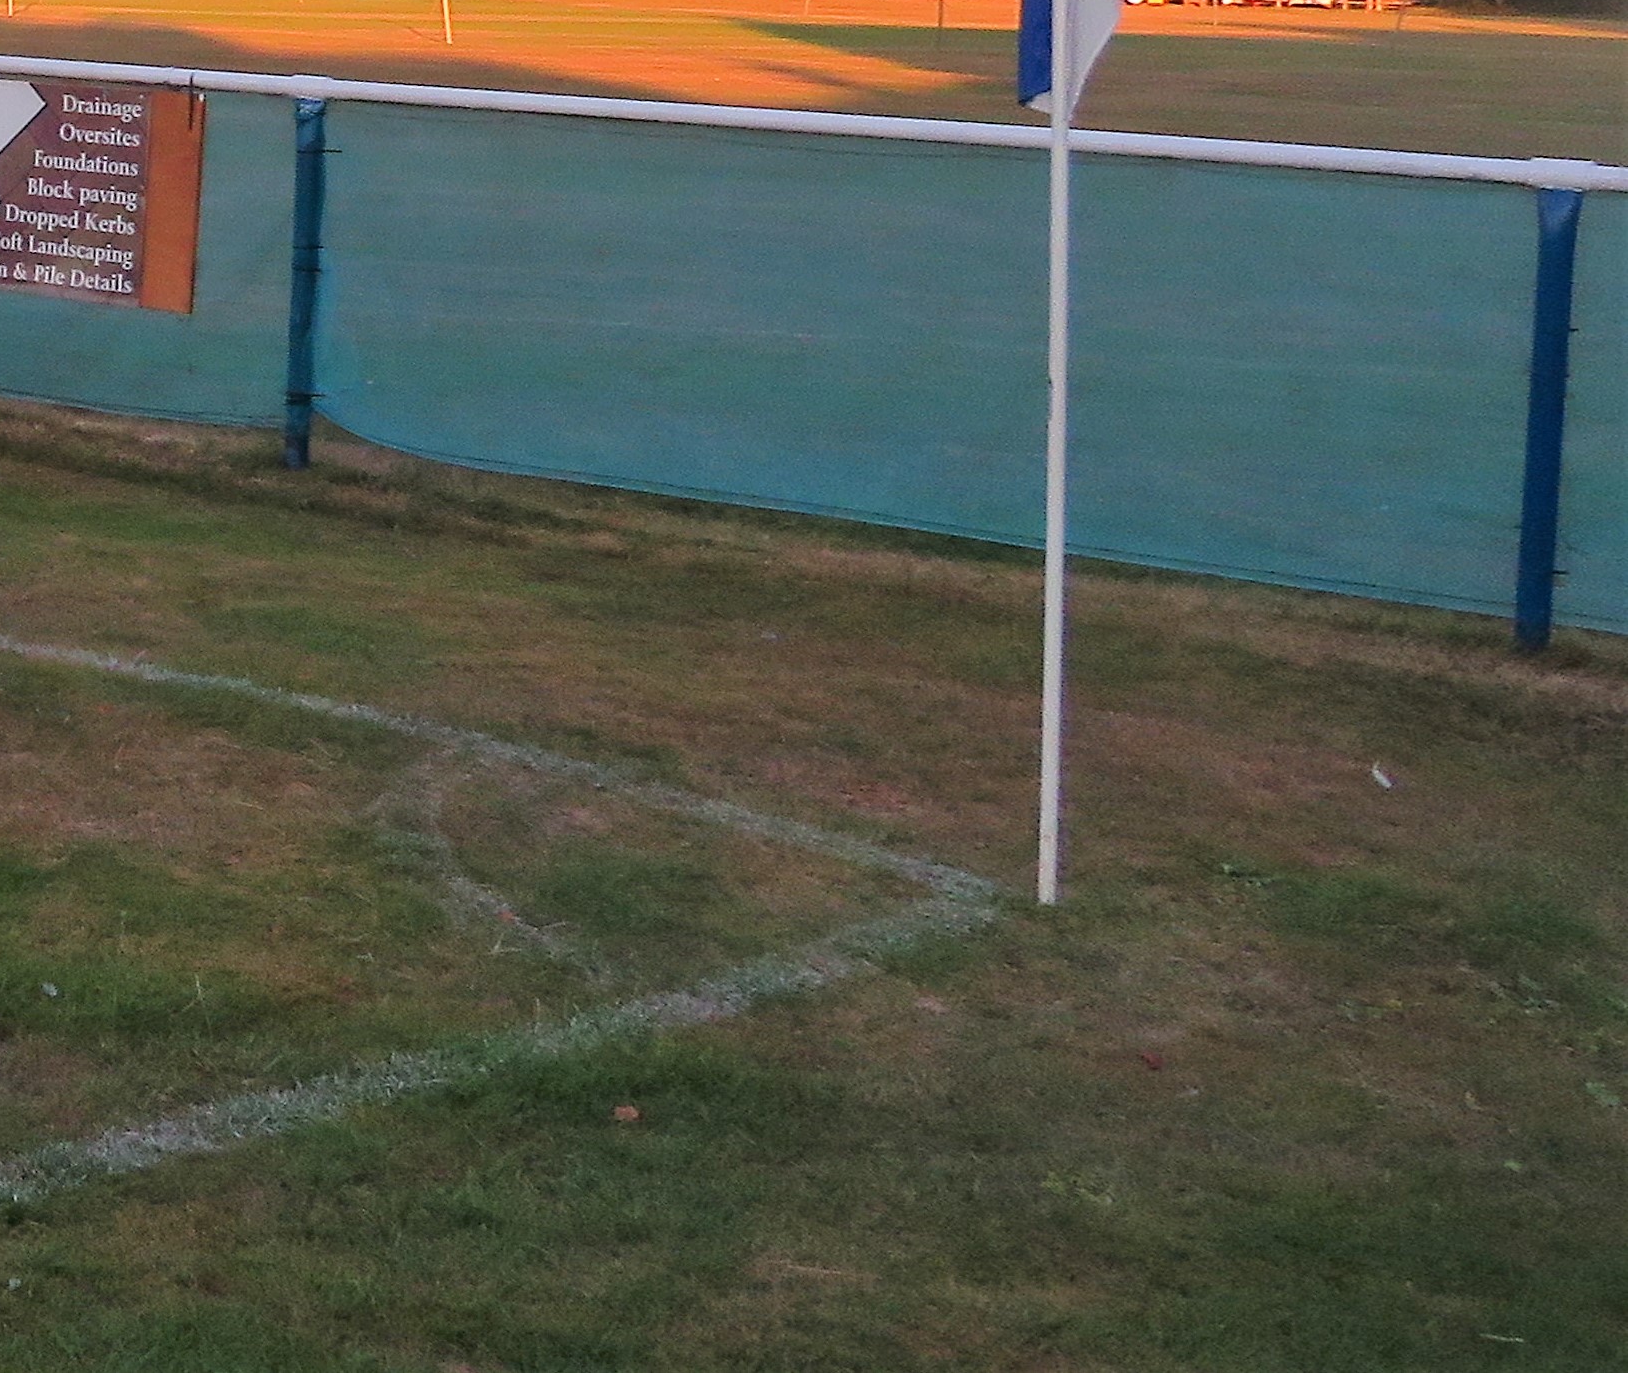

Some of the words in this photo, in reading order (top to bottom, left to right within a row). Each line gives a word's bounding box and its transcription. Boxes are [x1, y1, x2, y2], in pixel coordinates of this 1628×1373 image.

[62, 94, 143, 122] Drainage
[59, 123, 140, 147] Oversites
[33, 149, 139, 176] Foundations
[27, 177, 75, 199] Block
[79, 186, 138, 212] paving
[5, 204, 78, 231] Dropped
[85, 212, 136, 235] Kerbs
[29, 235, 134, 270] Landscaping
[13, 263, 27, 281] &
[34, 264, 65, 285] Pile
[70, 269, 133, 294] Details
